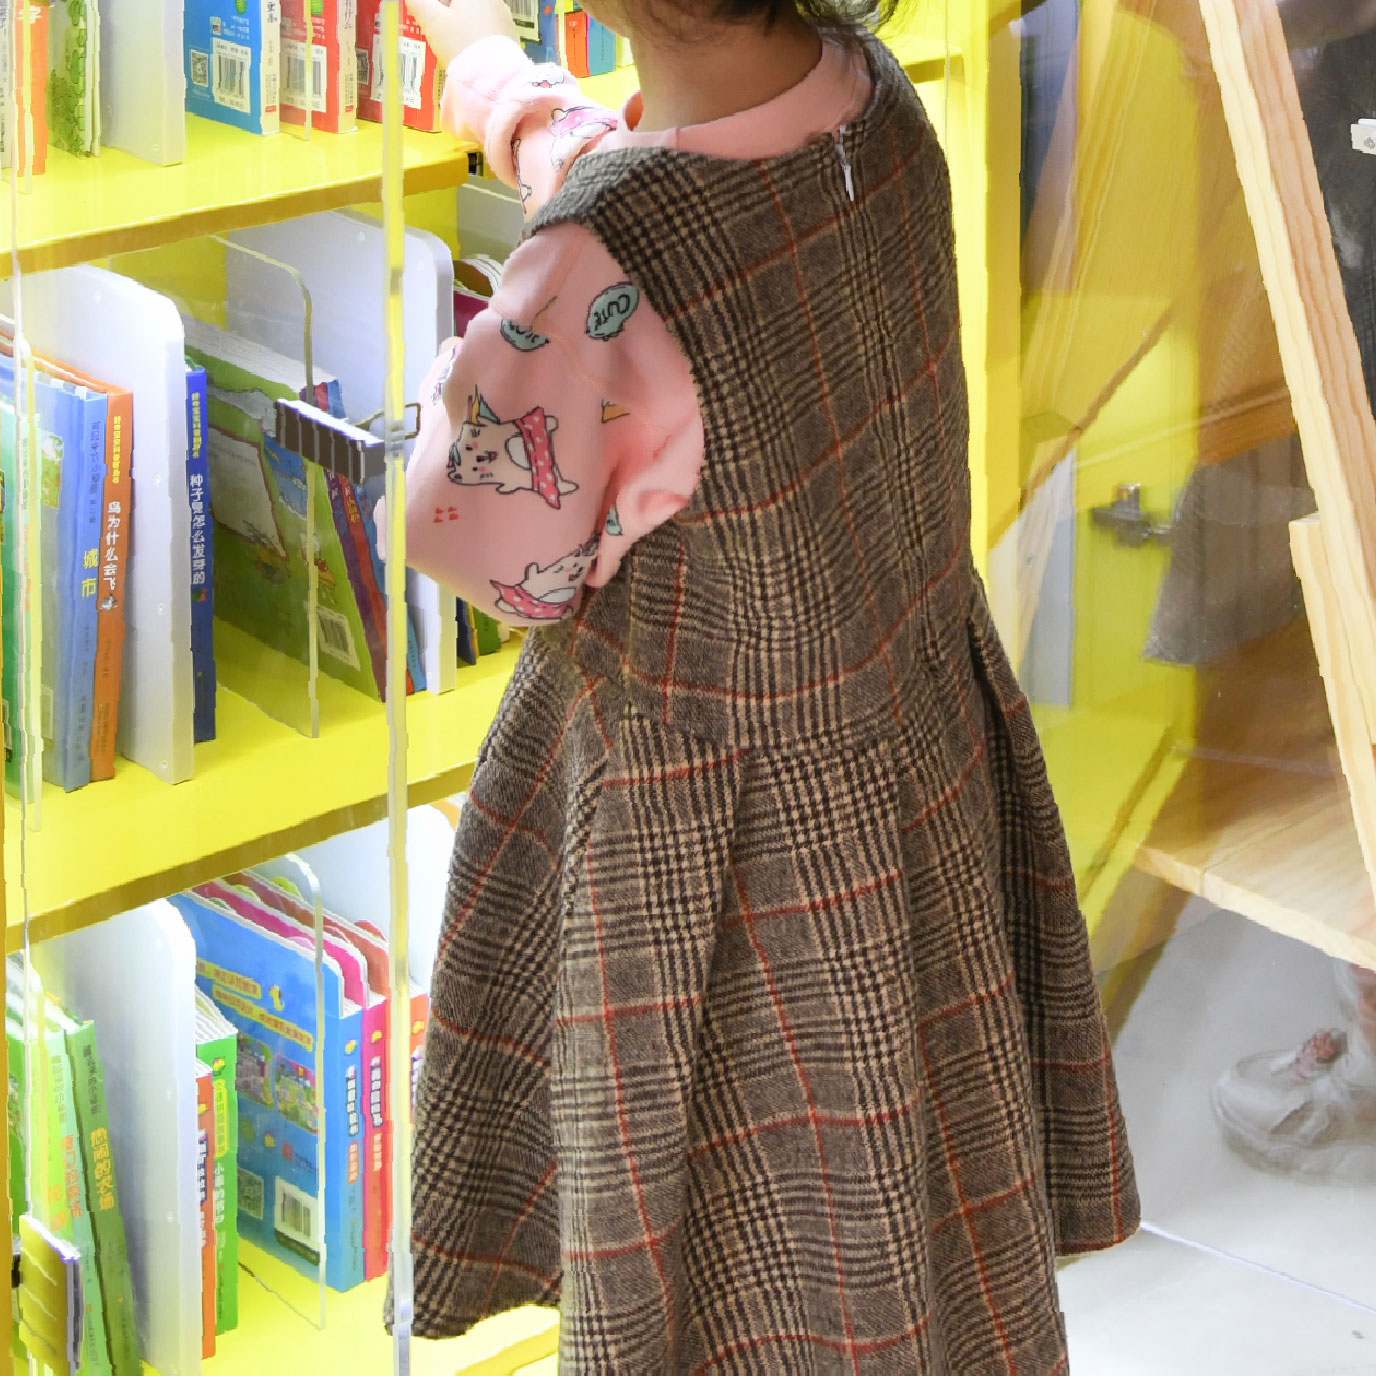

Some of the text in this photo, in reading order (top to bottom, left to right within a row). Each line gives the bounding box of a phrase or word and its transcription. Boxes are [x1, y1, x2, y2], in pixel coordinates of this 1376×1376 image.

[81, 547, 100, 599] 城市
[102, 500, 123, 592] 鸟为什么会飞
[189, 473, 206, 585] 种子是怎么发芽的
